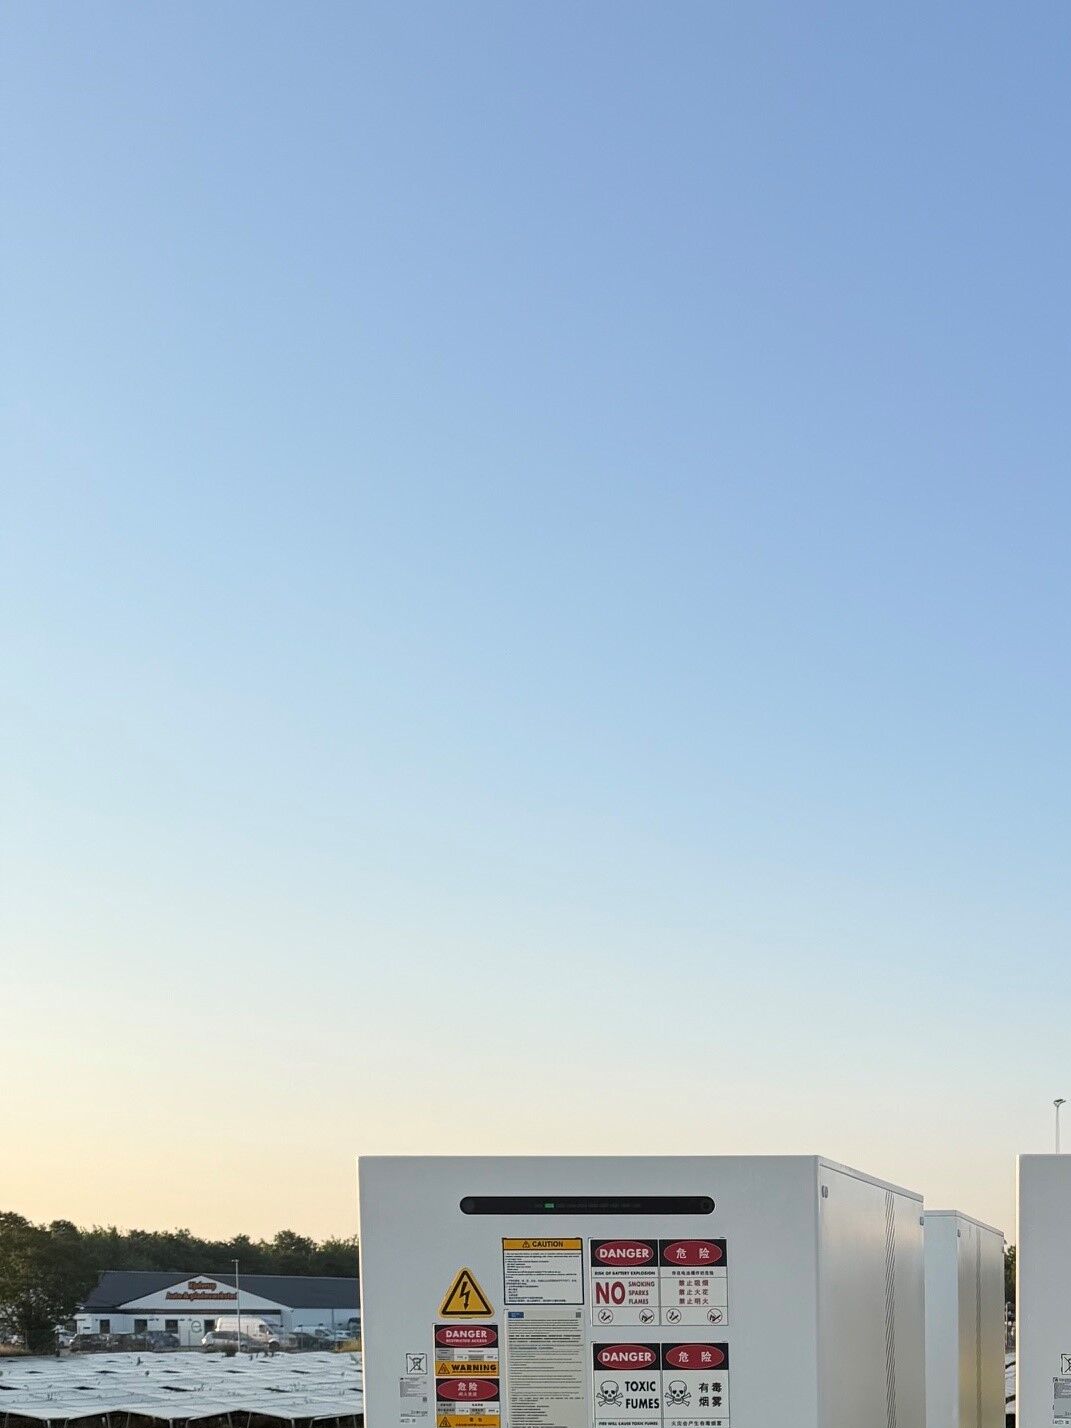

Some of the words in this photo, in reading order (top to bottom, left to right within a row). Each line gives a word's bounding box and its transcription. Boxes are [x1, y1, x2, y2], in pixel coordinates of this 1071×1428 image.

[599, 1248, 650, 1258] DANGER
[676, 1247, 710, 1259] 危险
[595, 1281, 626, 1305] NO
[446, 1330, 488, 1338] DANGER
[602, 1352, 652, 1362] DANGER
[678, 1351, 712, 1363] 危险
[625, 1381, 656, 1392] TOXIC
[625, 1398, 660, 1409] FUMES
